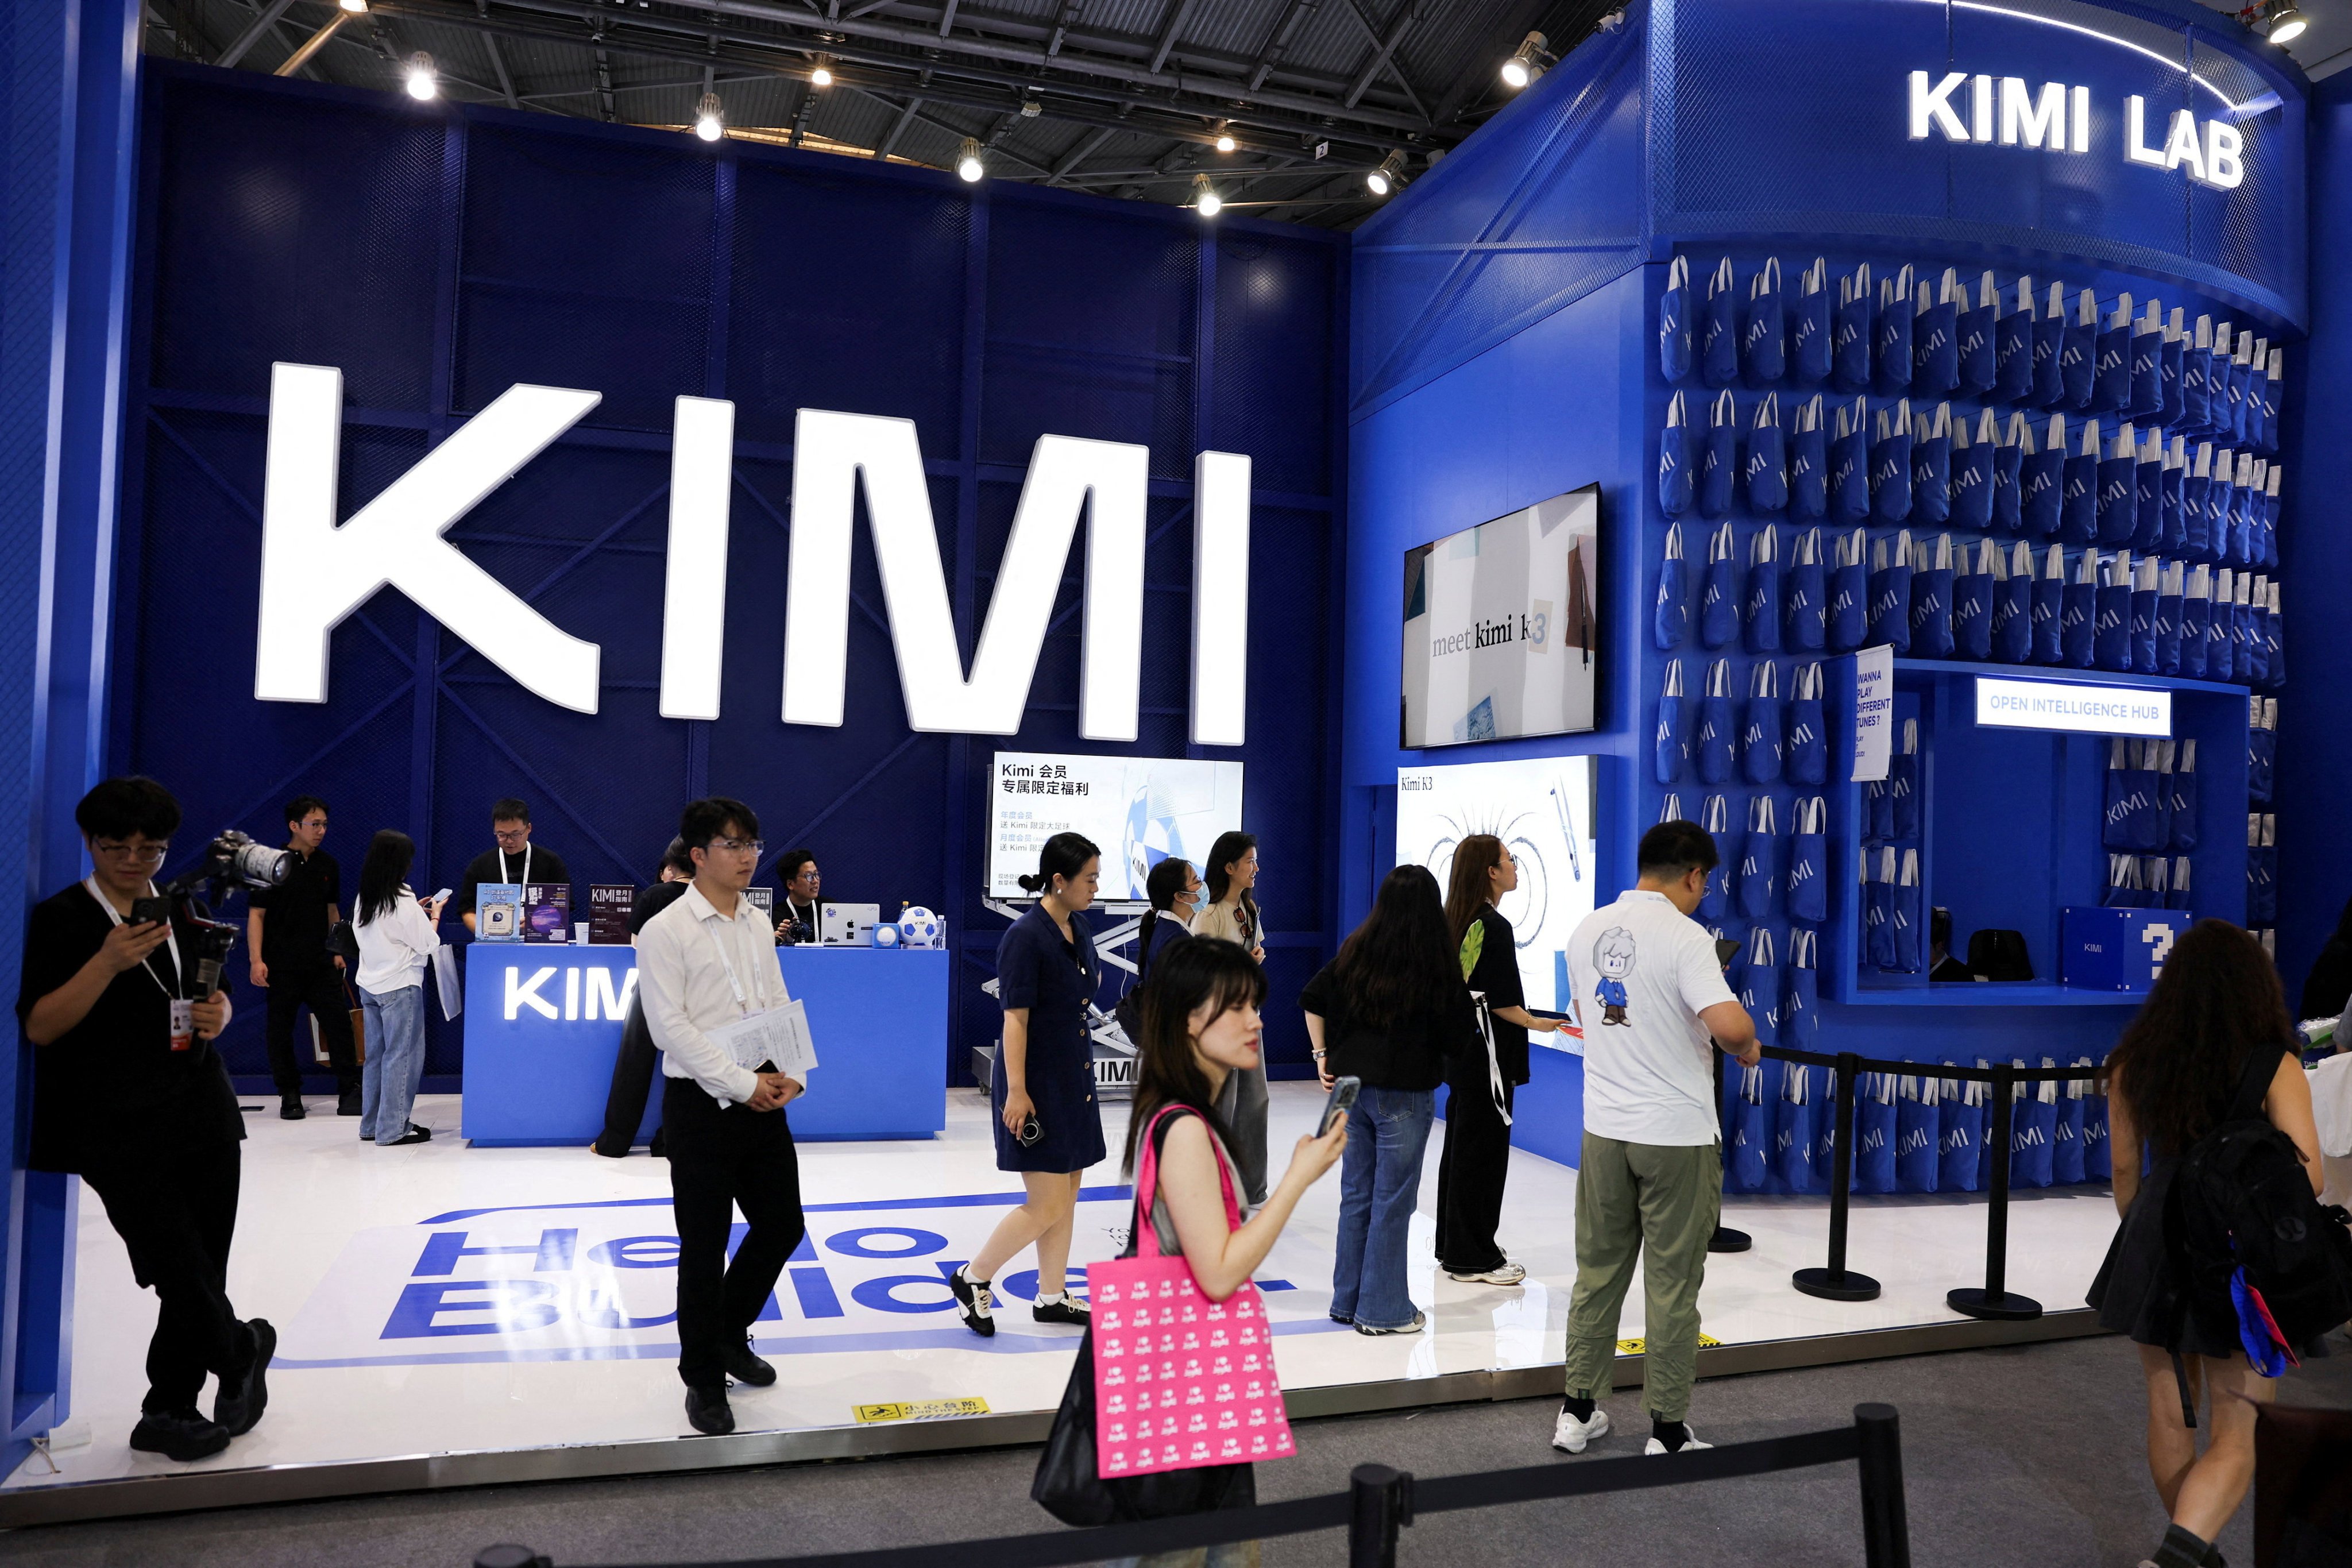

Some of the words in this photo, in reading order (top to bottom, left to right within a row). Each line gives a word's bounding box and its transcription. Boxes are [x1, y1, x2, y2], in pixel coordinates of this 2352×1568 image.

[1908, 70, 2090, 155] KIMI
[2123, 94, 2245, 192] LAB
[1320, 145, 1324, 156] 2
[1660, 314, 1676, 349] MI
[1795, 317, 1815, 352] MI
[1836, 324, 1857, 357] MI
[2032, 340, 2052, 369] MI
[2096, 350, 2122, 377] MI
[2131, 354, 2153, 381] MI
[1659, 451, 1675, 480] MI
[1747, 452, 1767, 486] MI
[2063, 478, 2085, 505] MI
[254, 361, 1251, 746] KIMI
[2030, 602, 2052, 629] MI
[2060, 606, 2084, 633] MI
[2095, 609, 2121, 636] MI
[1432, 628, 1470, 658] meet
[1475, 614, 1512, 649] kimi
[1521, 612, 1546, 644] k3
[1857, 670, 1882, 684] WANNA
[1857, 686, 1873, 698] PLAY
[1857, 698, 1891, 713] DIFFERENT
[1990, 695, 2028, 710] OPEN
[2033, 698, 2127, 718] INTELLIGENCE
[2132, 705, 2159, 720] HUB
[1744, 723, 1762, 752] MI
[1002, 764, 1034, 777] Kimi
[1039, 764, 1067, 779] 会员
[1401, 777, 1420, 791] Kimi
[1422, 777, 1433, 790] K3
[1002, 779, 1088, 796] 专属限定福利
[1001, 811, 1032, 819] 年度会员
[2107, 791, 2149, 825] KIMI
[1000, 834, 1032, 842] 月度会员
[1001, 821, 1008, 829] 送
[1030, 821, 1071, 831] 限定大足球
[999, 844, 1007, 852] 送
[1132, 856, 1146, 881] KIMI
[592, 889, 615, 902] KIMI
[2084, 943, 2102, 953] KIMI
[2142, 924, 2174, 980] ?
[503, 966, 639, 1021] KIM
[1778, 1128, 1792, 1152] MI
[2054, 1121, 2074, 1145] MI
[411, 1222, 948, 1277] Heo
[905, 1401, 976, 1412] 小心台阶
